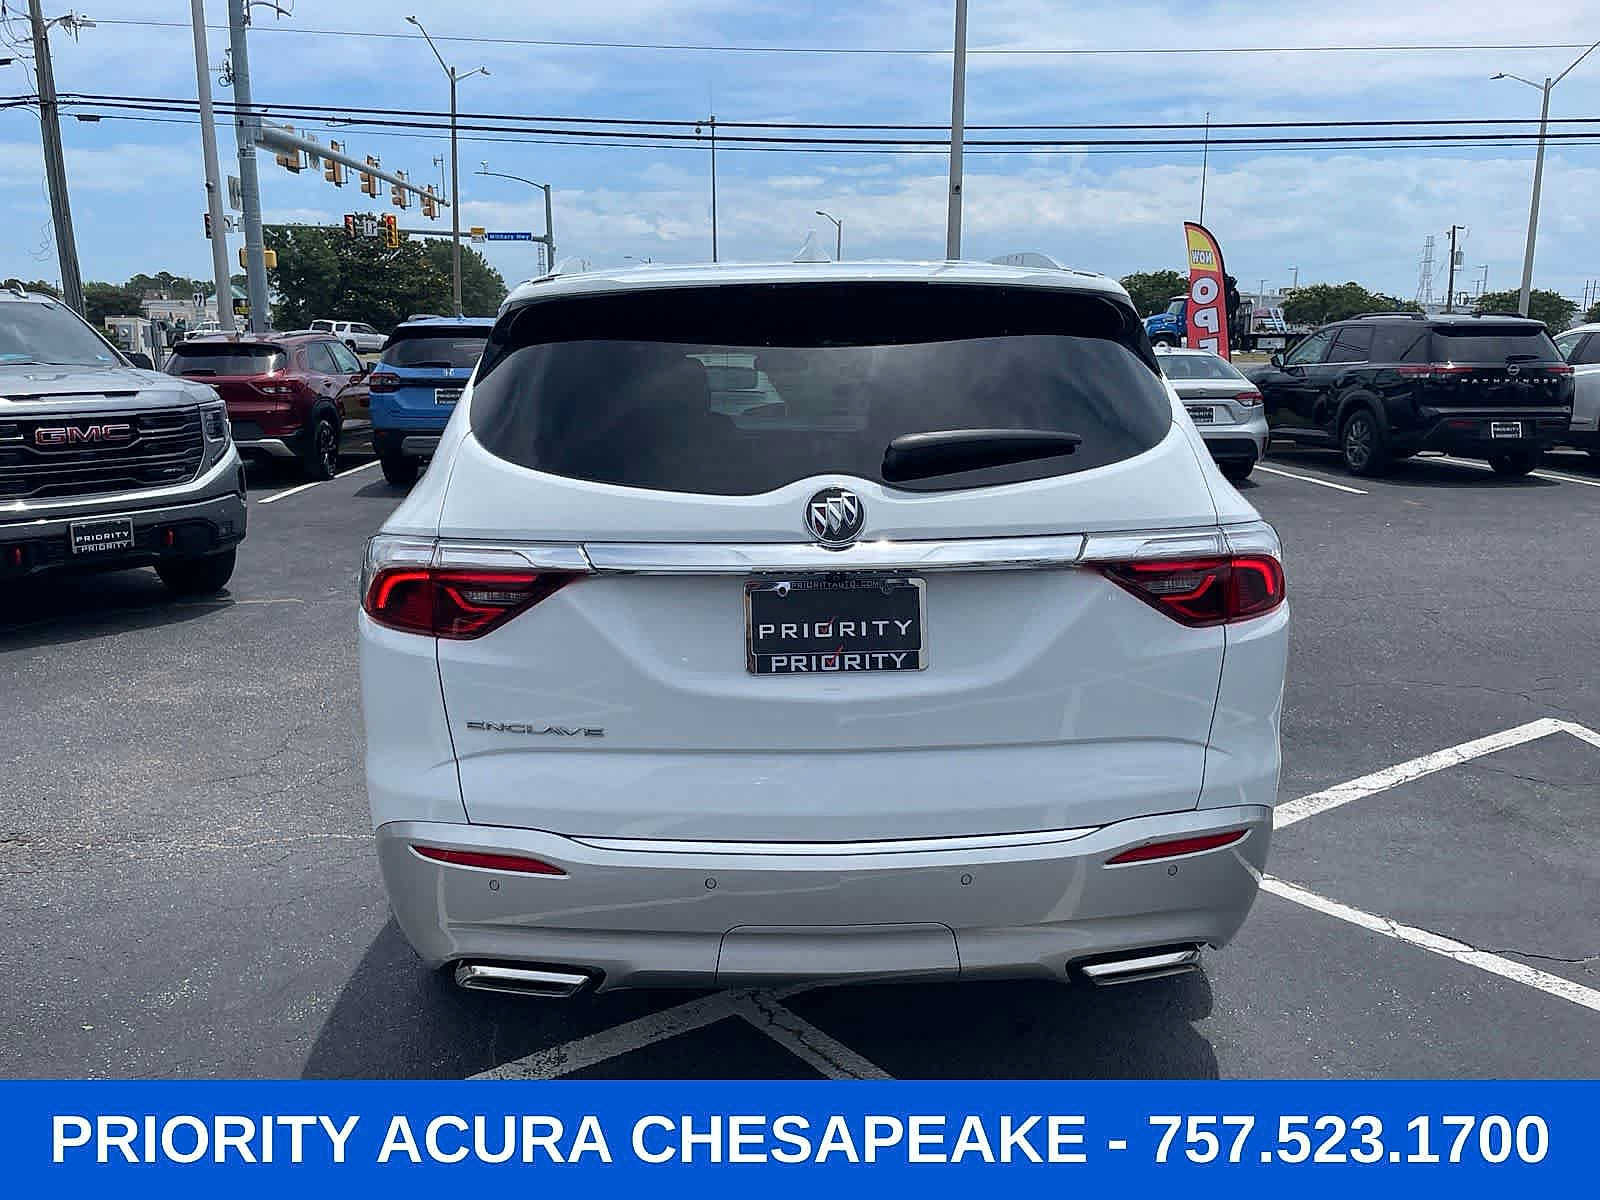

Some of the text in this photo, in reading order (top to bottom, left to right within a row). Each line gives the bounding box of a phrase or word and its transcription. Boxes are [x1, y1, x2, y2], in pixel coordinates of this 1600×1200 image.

[34, 424, 130, 445] GMC
[76, 531, 129, 543] PRIORITY
[81, 542, 128, 553] PRIORITY
[758, 619, 913, 640] PRIORITY
[771, 652, 908, 672] PRIORITY
[466, 721, 605, 737] ENCLAVE
